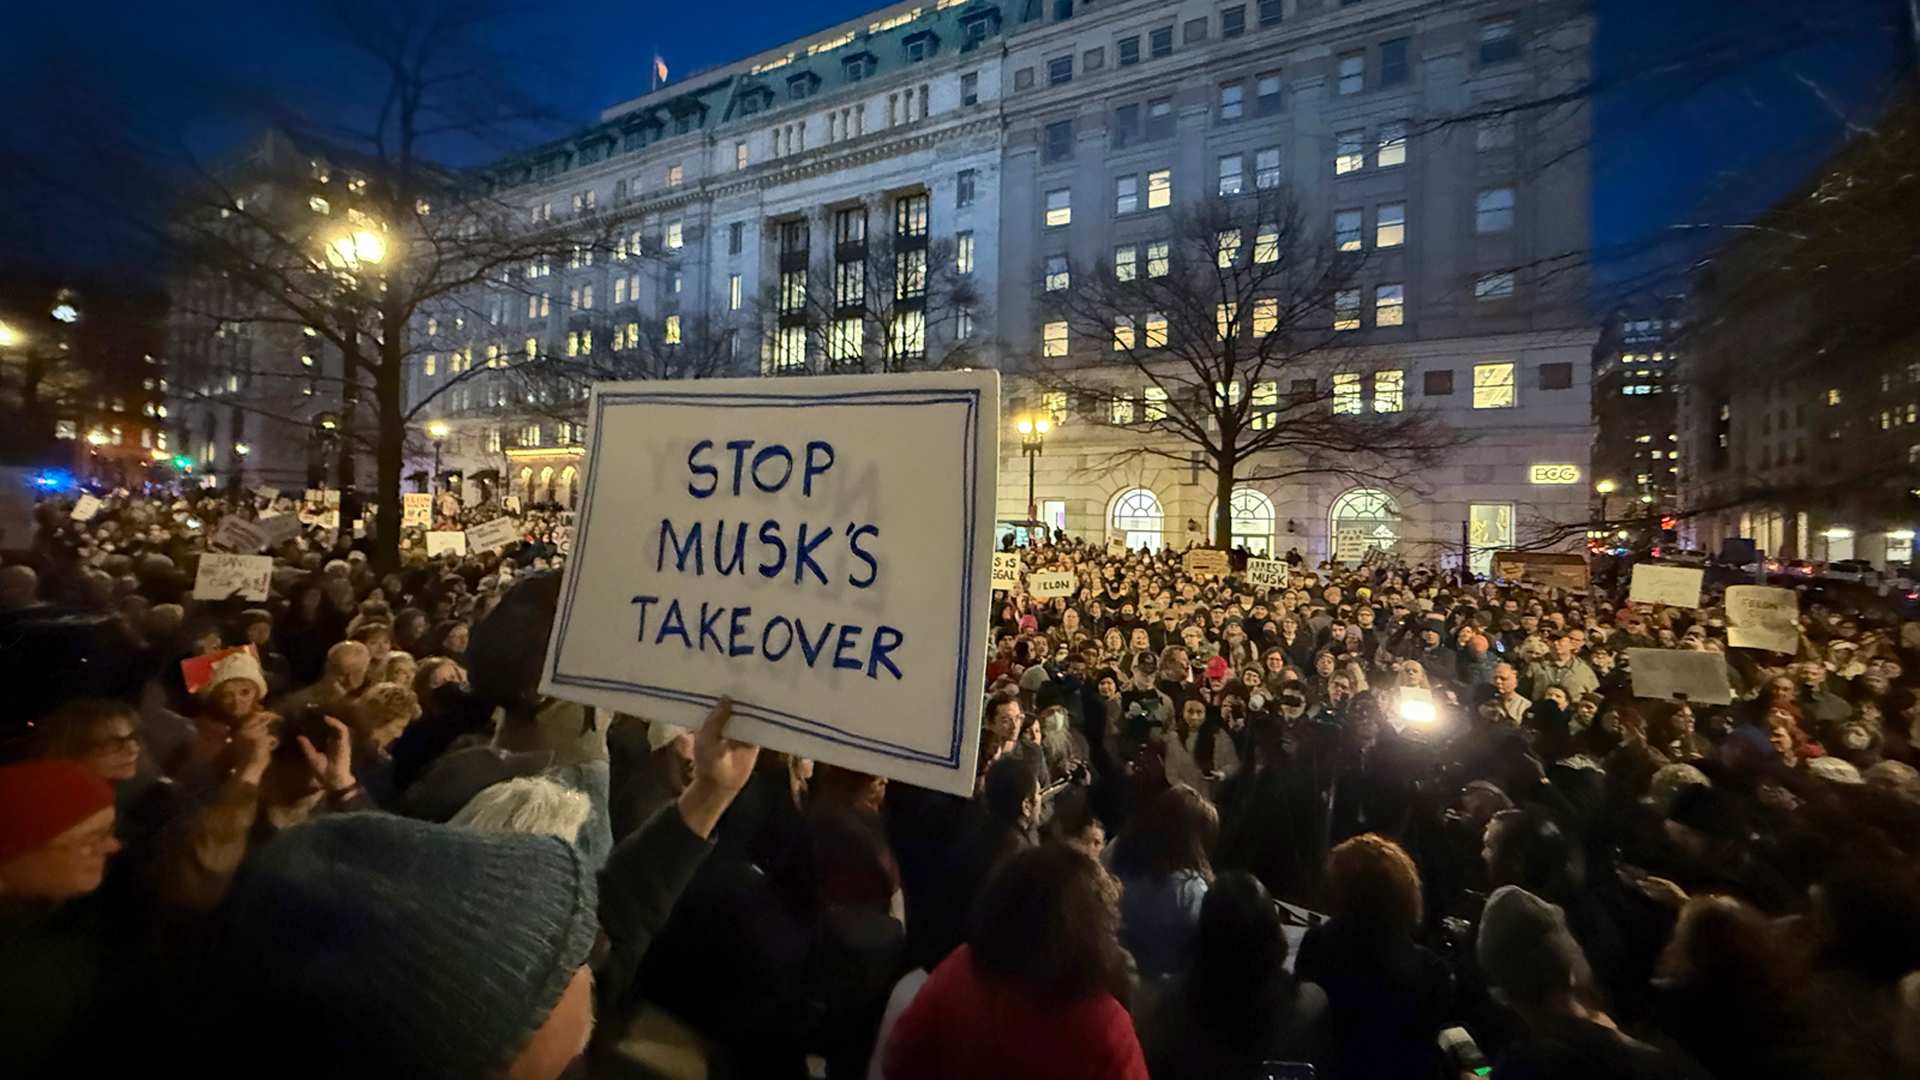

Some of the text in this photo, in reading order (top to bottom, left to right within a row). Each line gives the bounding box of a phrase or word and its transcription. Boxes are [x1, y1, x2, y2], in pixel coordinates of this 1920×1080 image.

[688, 439, 835, 499] STOP
[656, 518, 880, 589] MUSK'S
[1005, 557, 1017, 568] IS
[1247, 561, 1287, 574] ARREST
[1251, 572, 1286, 586] MUSK
[631, 595, 905, 681] TAKEOVER
